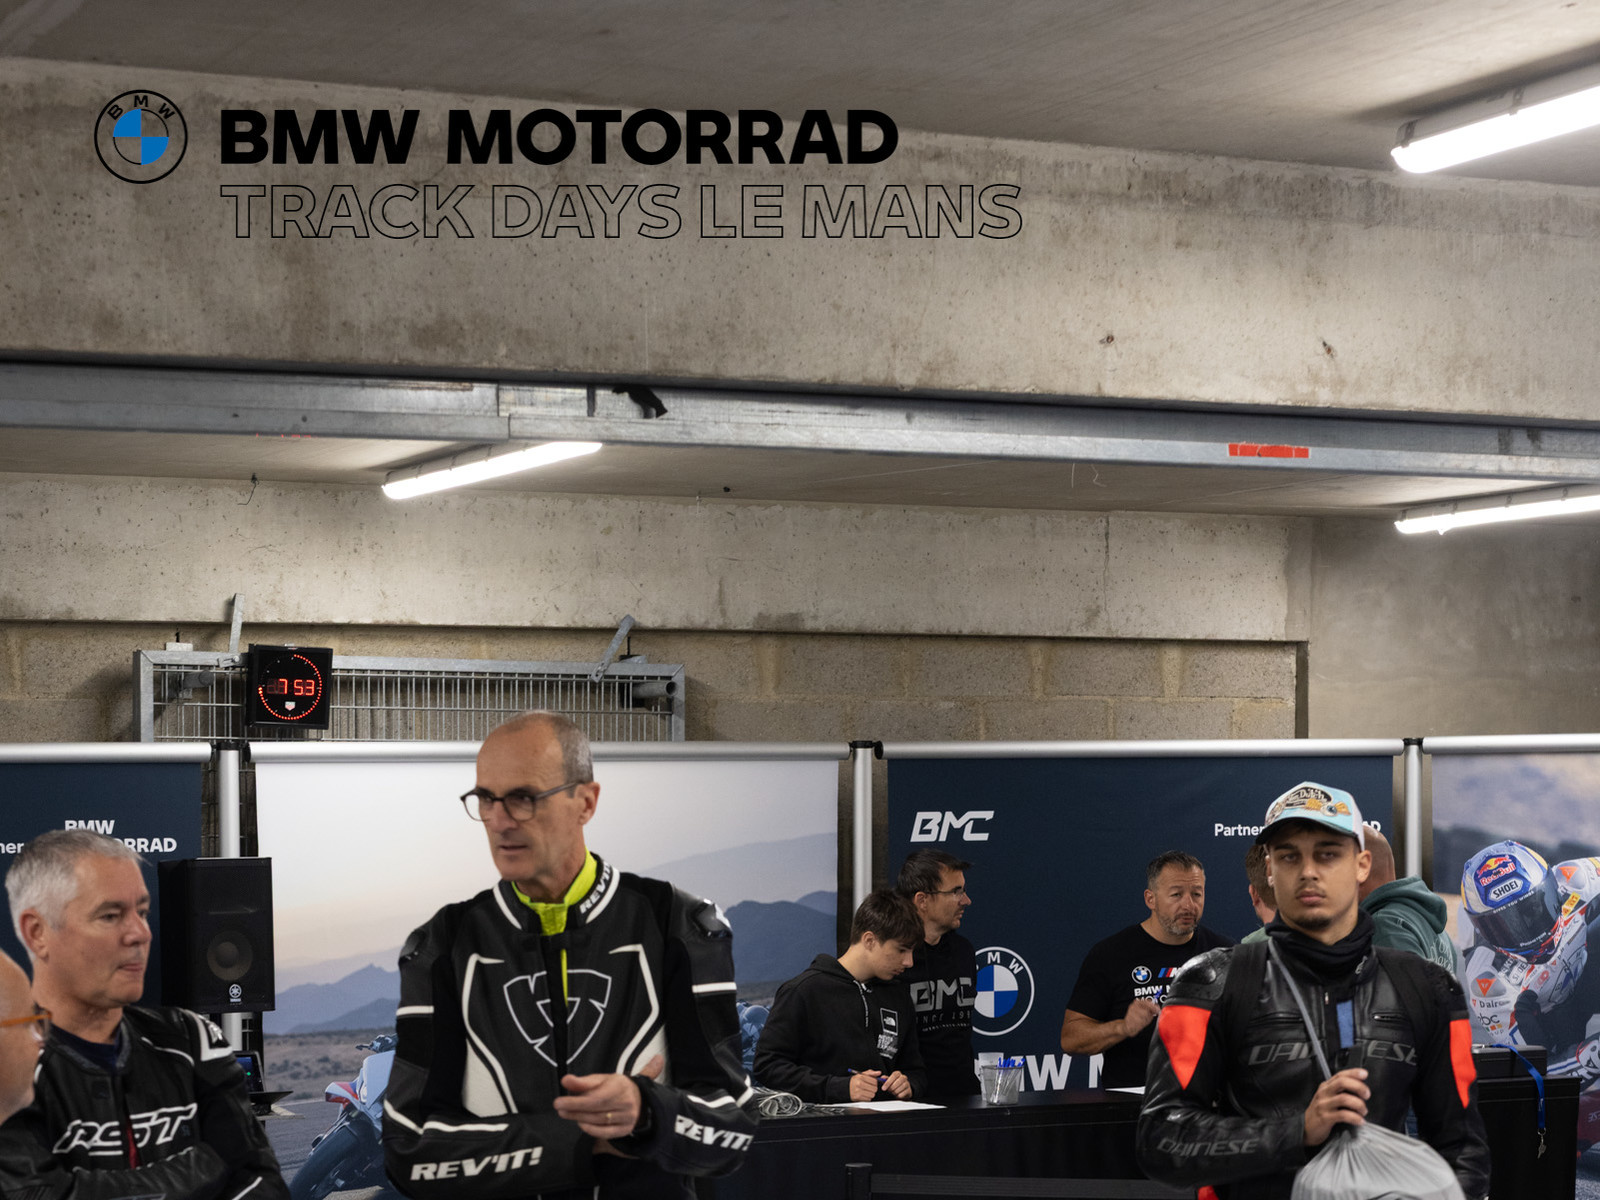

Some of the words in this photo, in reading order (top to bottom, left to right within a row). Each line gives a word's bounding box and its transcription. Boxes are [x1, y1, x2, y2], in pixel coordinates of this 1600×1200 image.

[909, 810, 995, 843] BMC
[1214, 822, 1266, 838] Partner
[1492, 880, 1519, 899] SHOEI
[976, 951, 1024, 976] MW
[1248, 1038, 1418, 1067] DAIESE
[1156, 1137, 1260, 1158] DAINESE
[410, 1146, 544, 1182] REV'IT!
